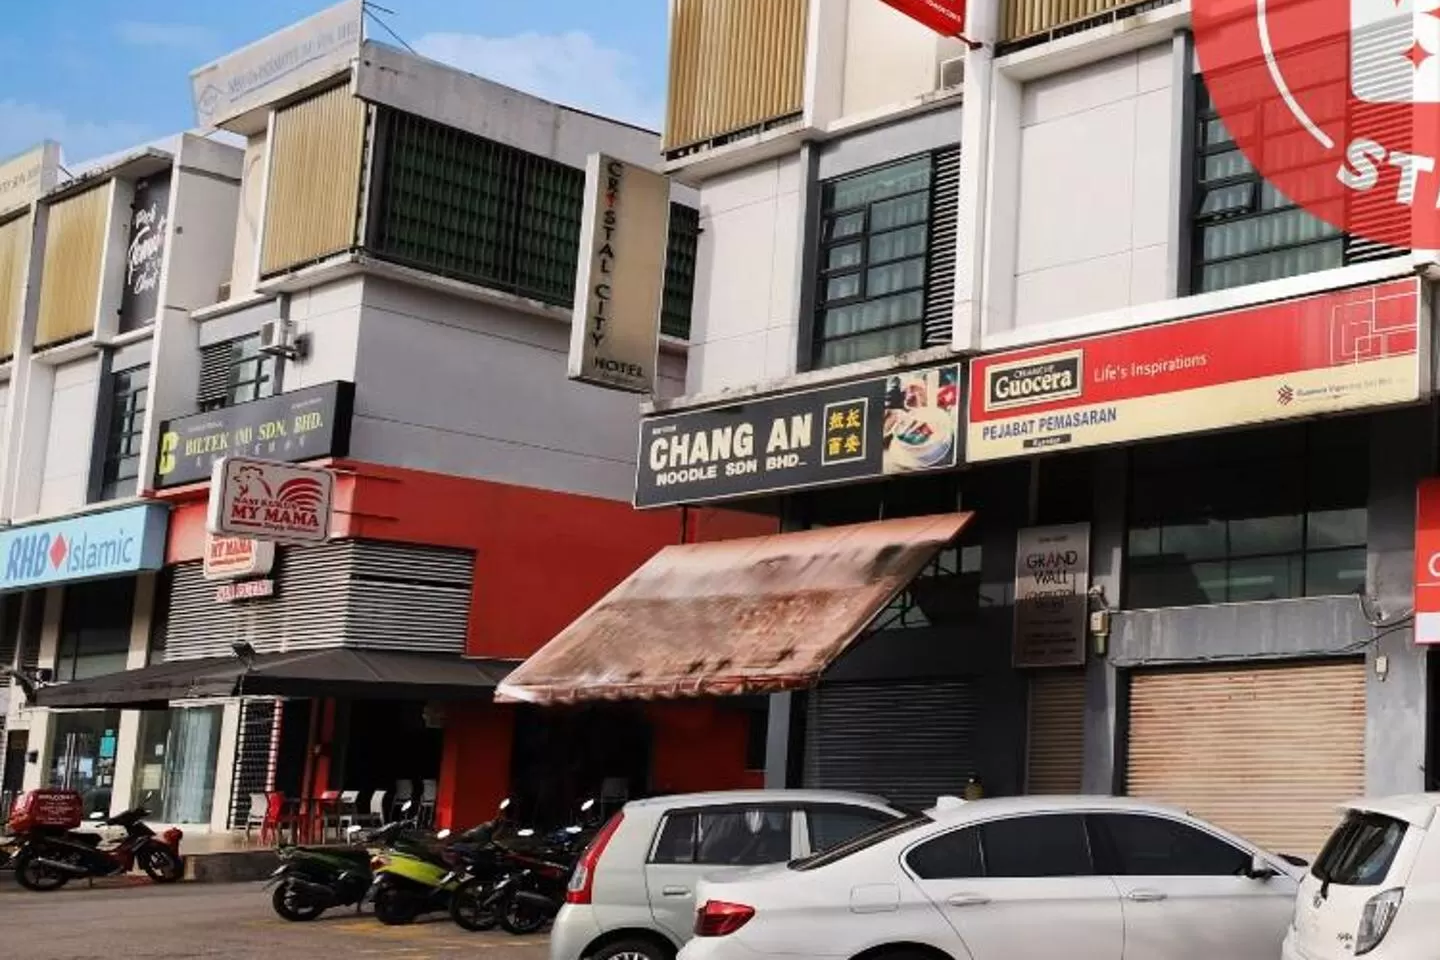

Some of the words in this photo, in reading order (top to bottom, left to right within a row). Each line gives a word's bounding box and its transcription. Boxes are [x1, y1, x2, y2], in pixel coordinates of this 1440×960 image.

[599, 162, 622, 274] CRYSTAL
[590, 284, 611, 350] CITY
[594, 356, 644, 378] HOTEL
[1094, 366, 1129, 382] Life's
[1131, 353, 1207, 377] Inspirations
[995, 370, 1073, 399] Guocera
[983, 420, 1035, 441] PEJABAT
[1039, 408, 1117, 433] PEMASARAN
[650, 424, 754, 471] CHANG
[766, 413, 813, 453] AN
[656, 466, 718, 487] NOODLE
[725, 460, 758, 476] SDN
[231, 505, 260, 519] MY
[265, 508, 319, 527] MAMA
[6, 532, 48, 580] RHB
[66, 528, 134, 573] Islamic
[1026, 551, 1077, 569] GRAND
